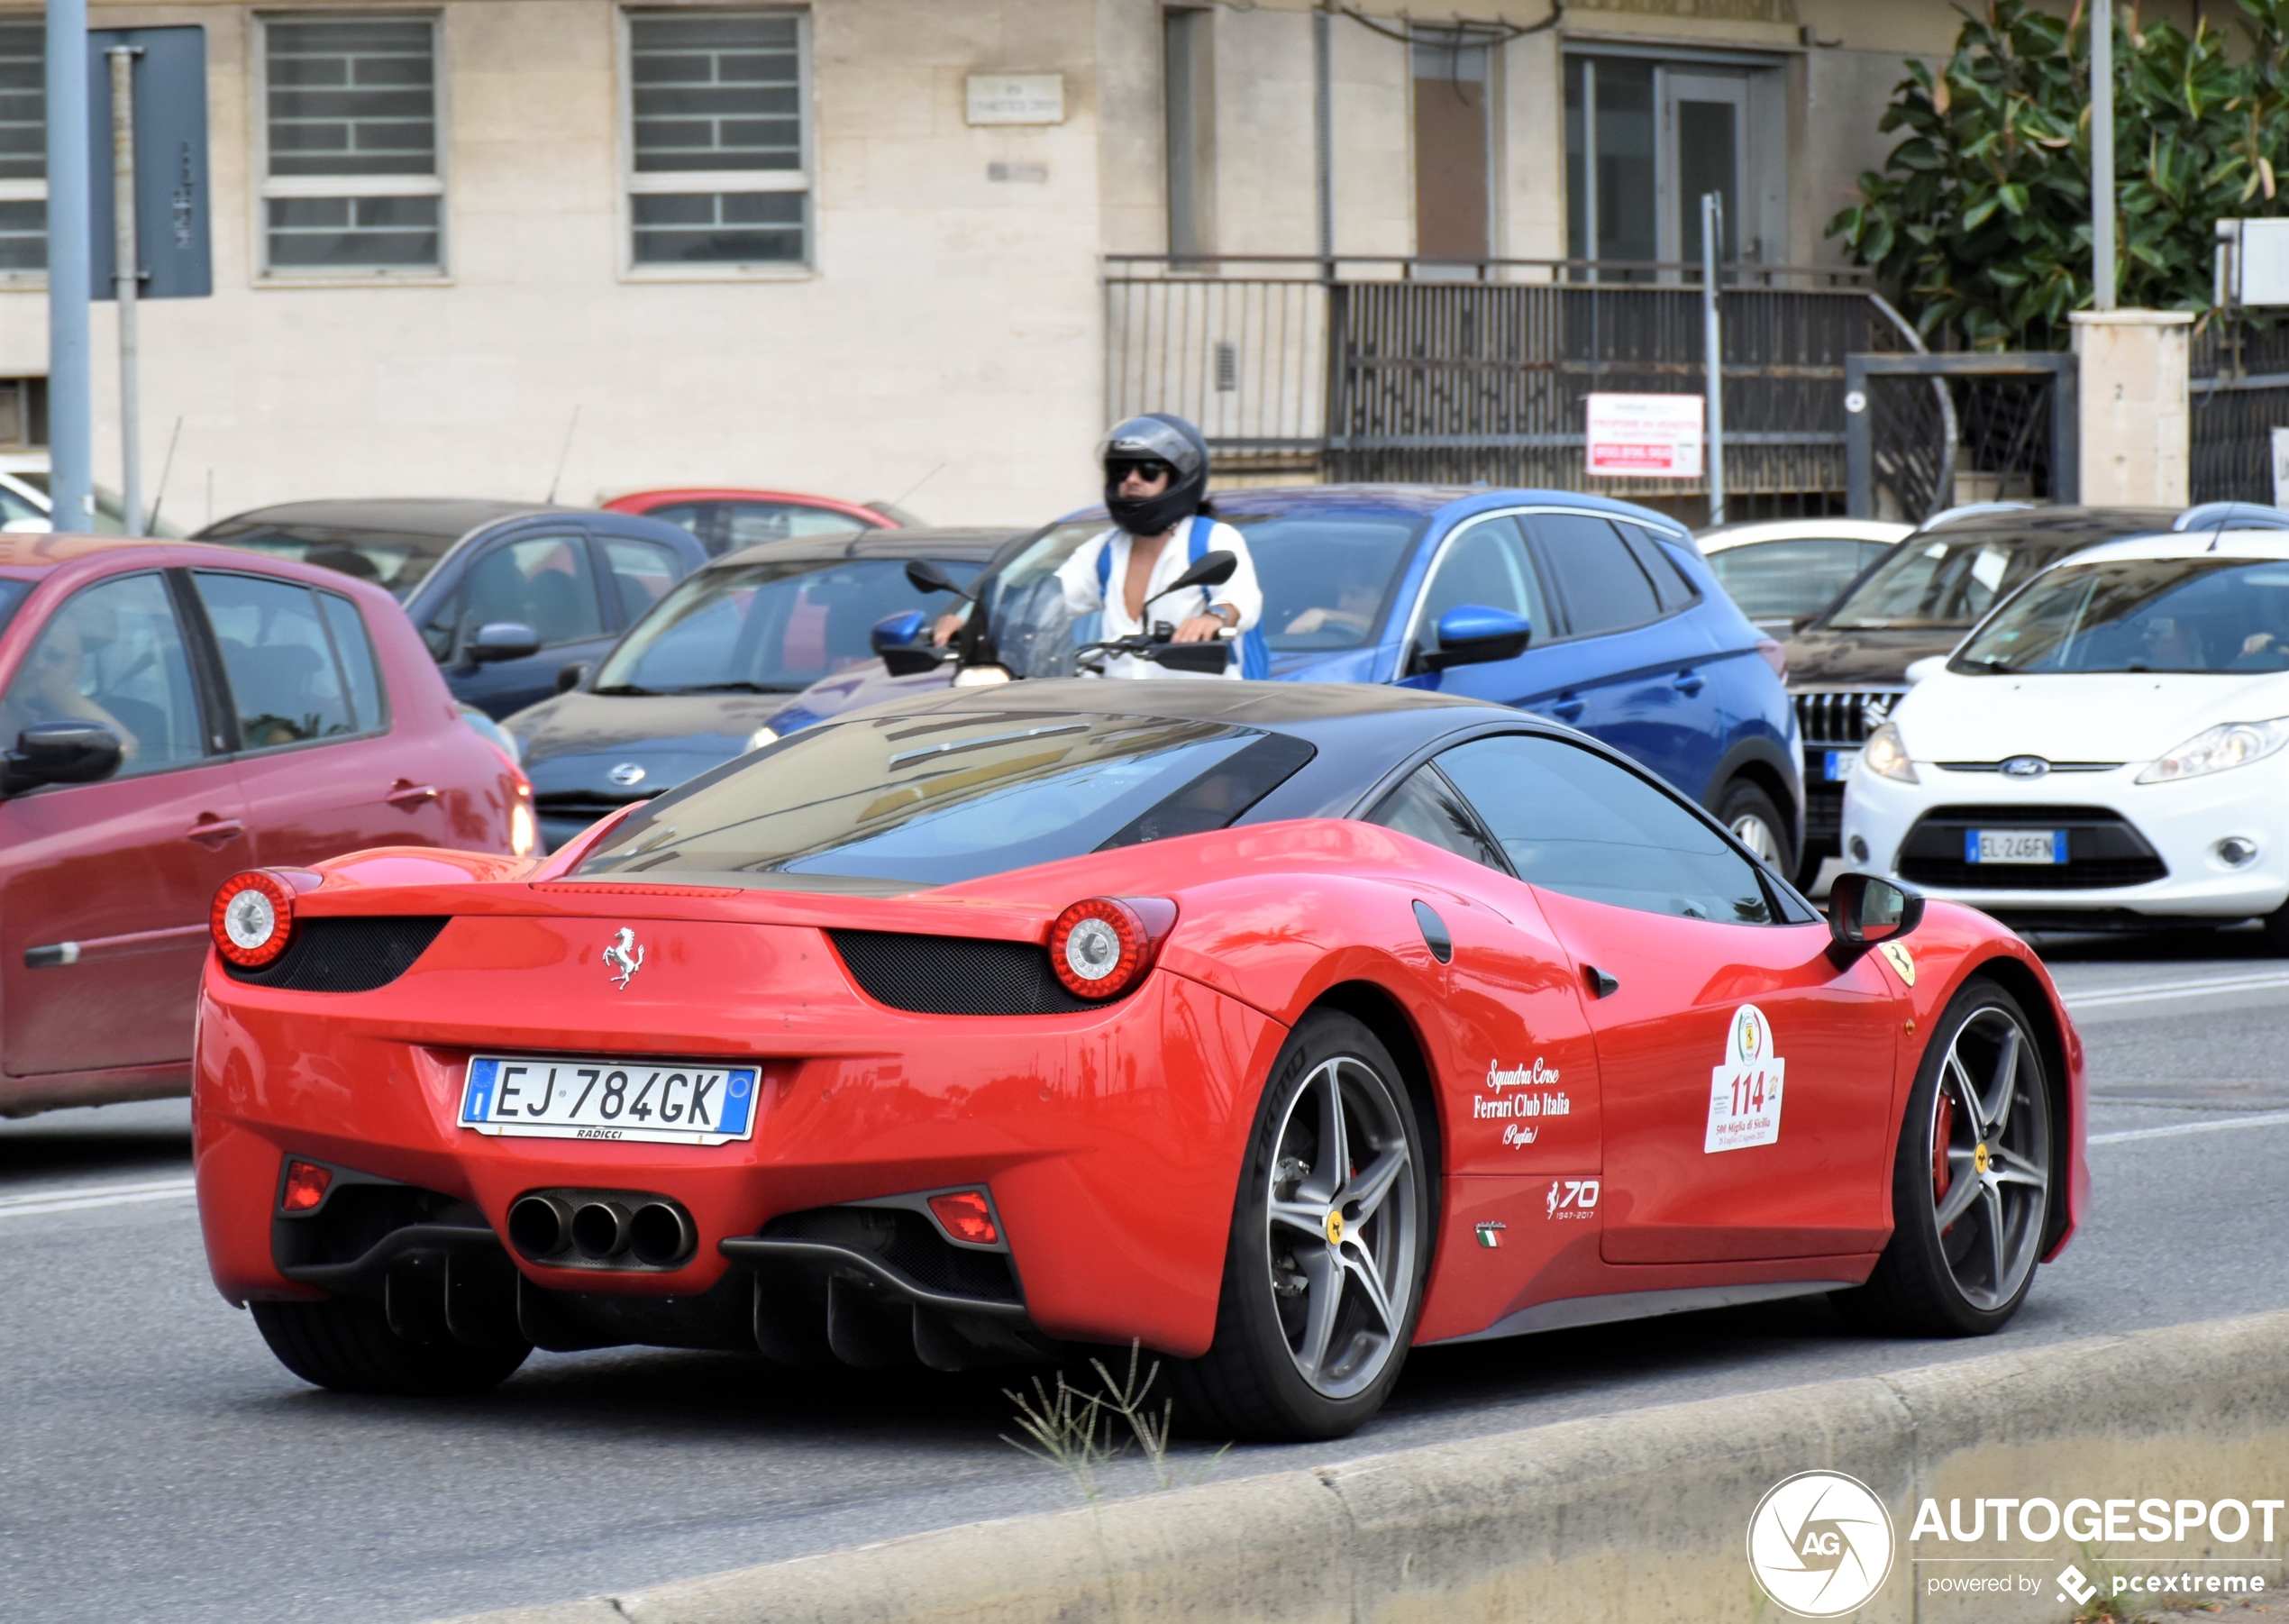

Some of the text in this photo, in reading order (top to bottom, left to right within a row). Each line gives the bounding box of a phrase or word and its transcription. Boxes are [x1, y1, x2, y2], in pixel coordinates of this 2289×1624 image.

[2113, 382, 2123, 400] 2
[1487, 1057, 1559, 1094] Squadra Corse
[1473, 1092, 1570, 1118] Ferrari Club Italia
[1731, 1071, 1765, 1117] 114
[577, 1129, 623, 1139] RADICCI
[1502, 1124, 1538, 1150] (Puglia)
[1716, 1118, 1771, 1136] 500 Miglia di Sicilia
[1560, 1181, 1600, 1208] 70
[1556, 1211, 1594, 1219] 1947-2017
